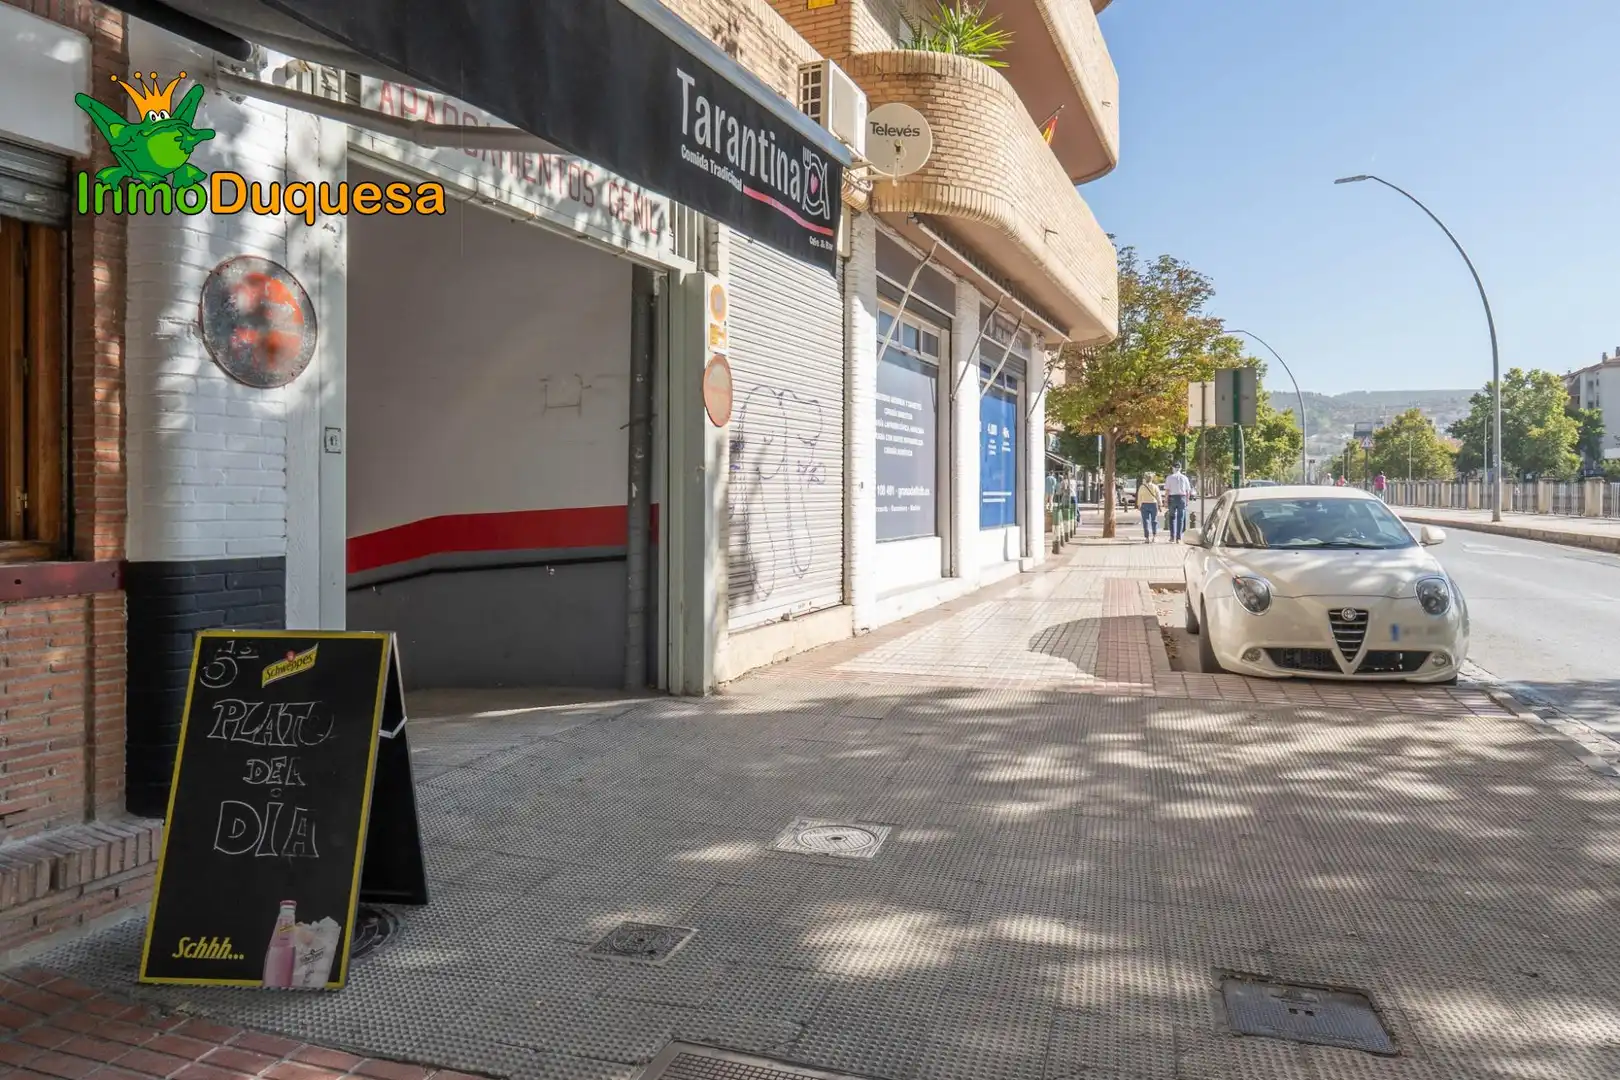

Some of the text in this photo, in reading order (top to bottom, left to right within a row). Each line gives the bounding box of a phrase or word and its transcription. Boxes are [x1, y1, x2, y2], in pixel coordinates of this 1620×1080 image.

[676, 67, 801, 204] Tarantina
[868, 121, 921, 138] Televés
[681, 143, 710, 173] Comida
[608, 178, 659, 236] GENIL
[265, 652, 313, 680] Schweppes
[171, 935, 245, 960] Schhh...
